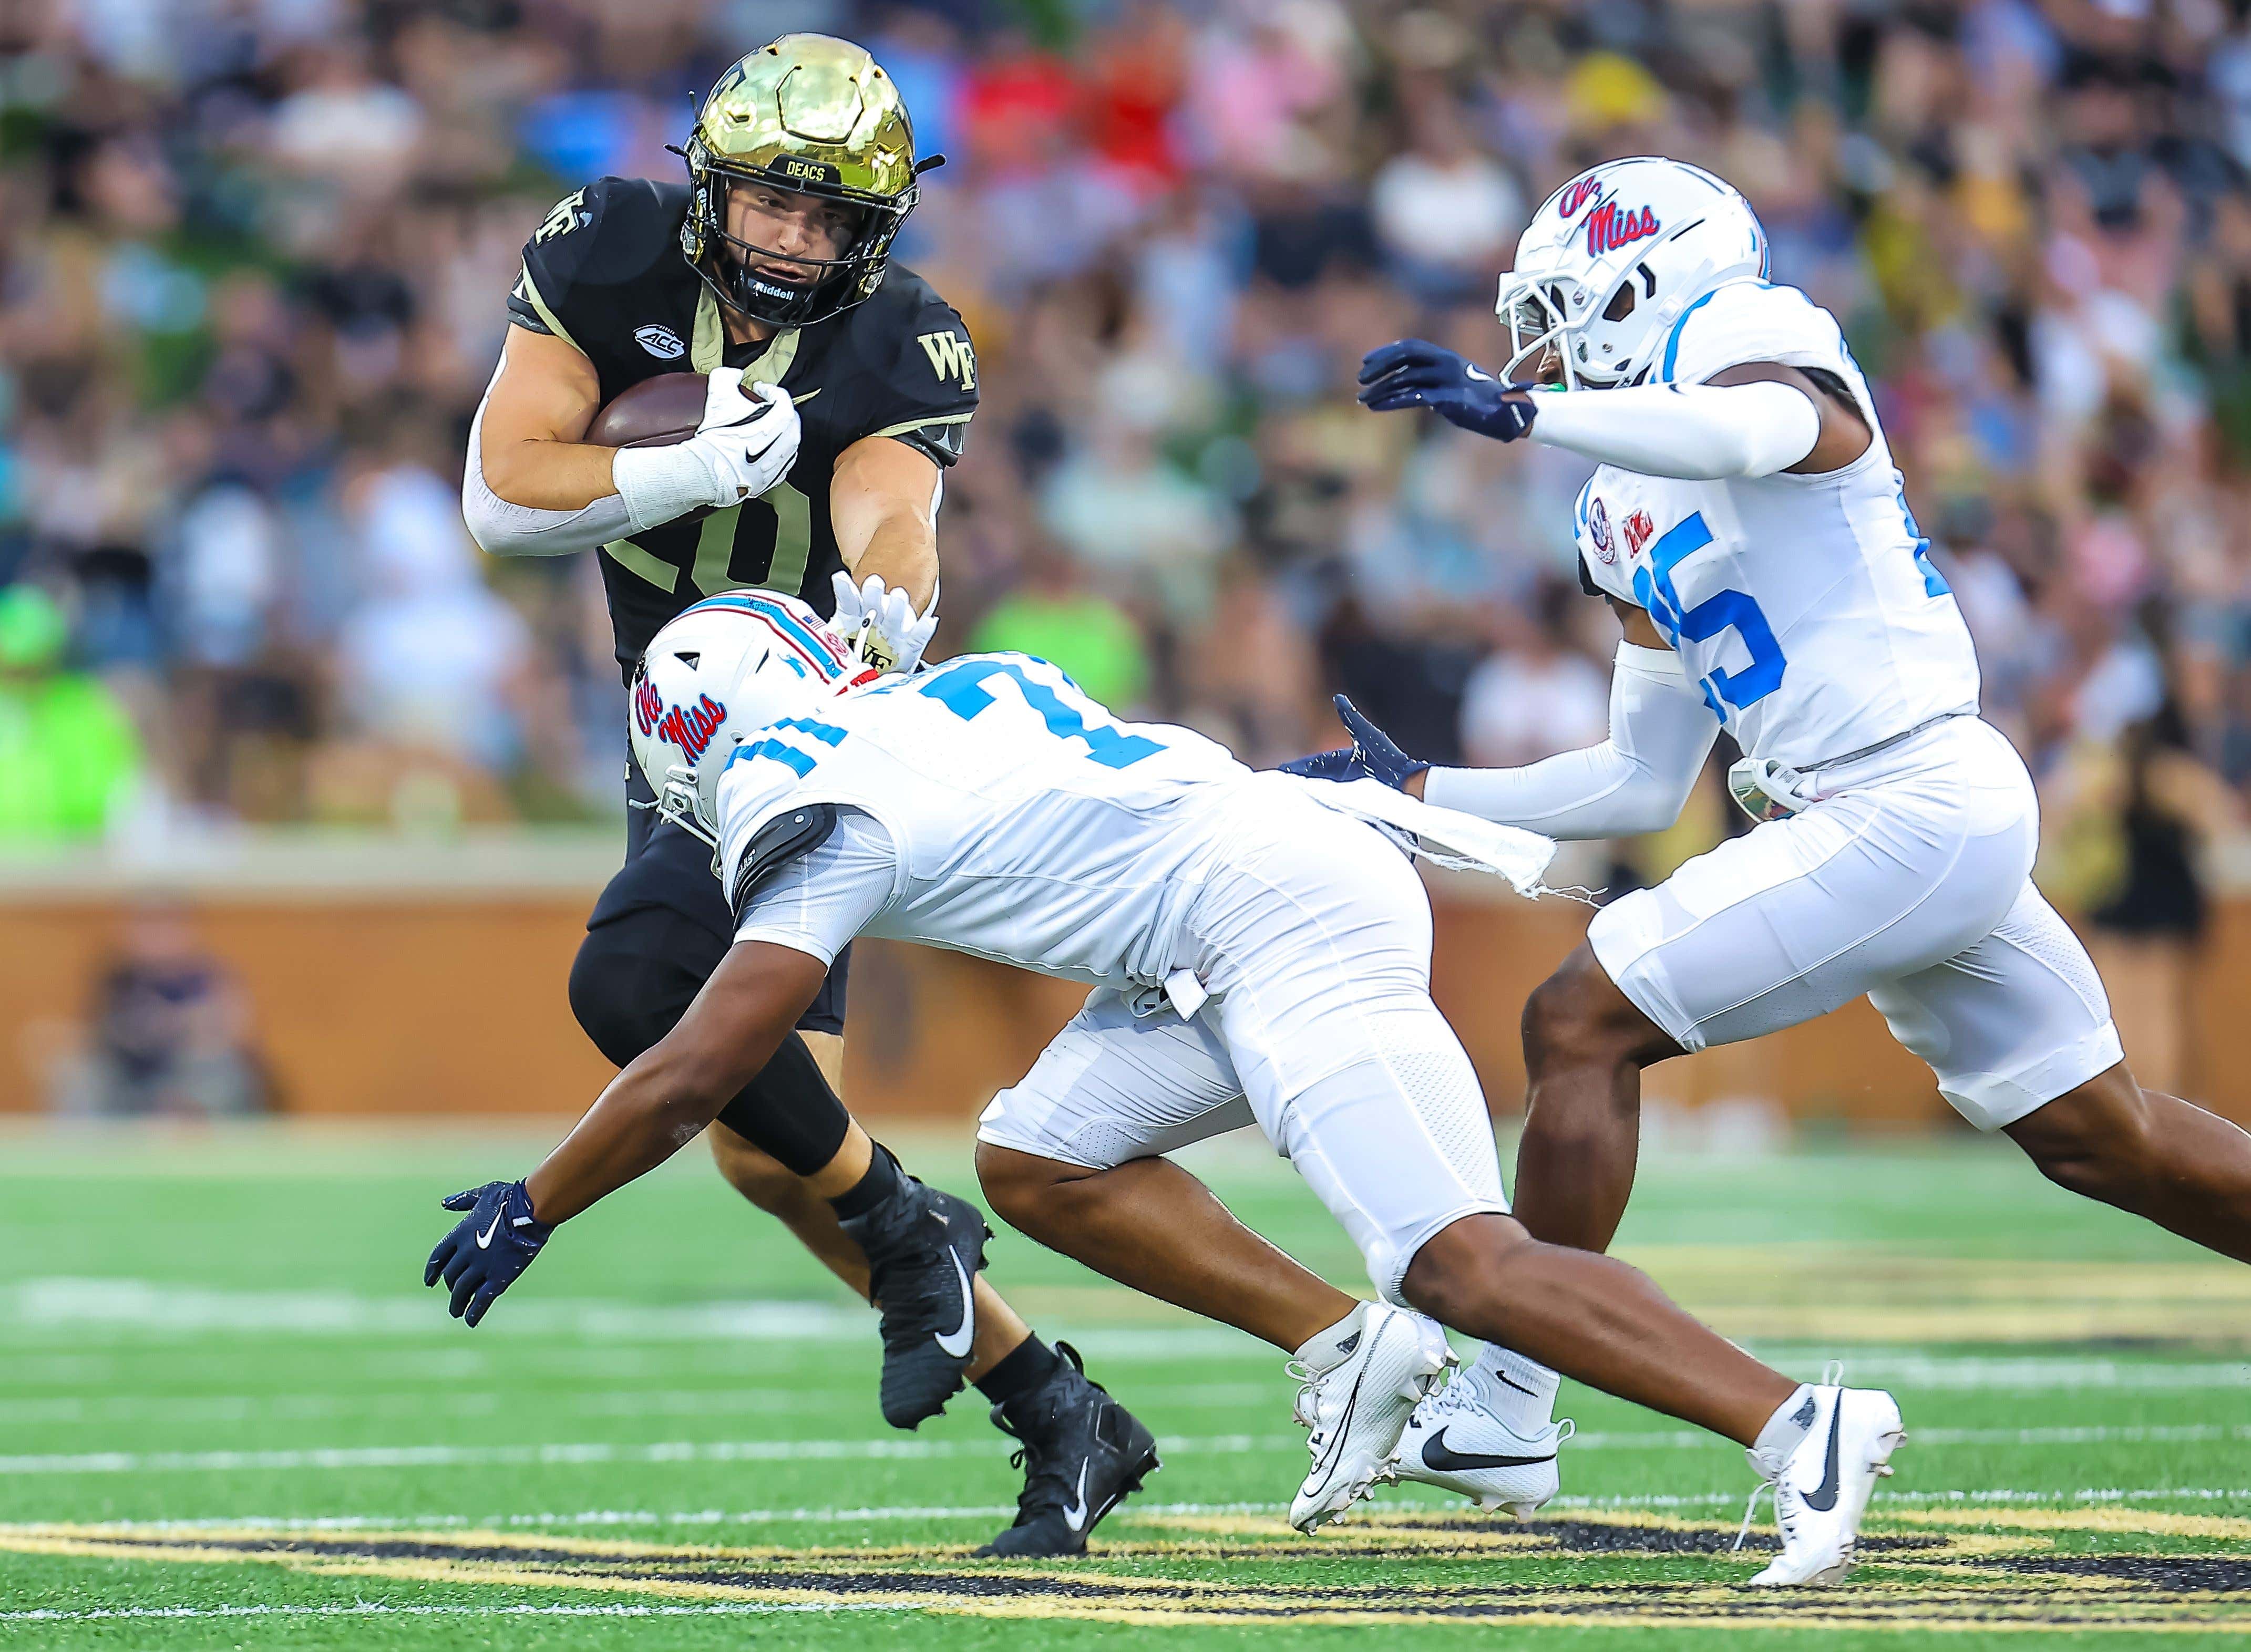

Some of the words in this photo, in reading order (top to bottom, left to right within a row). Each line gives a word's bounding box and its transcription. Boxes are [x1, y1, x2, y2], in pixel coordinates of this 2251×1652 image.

[786, 161, 825, 182] DEACS
[1580, 201, 1660, 257] Miss
[753, 282, 794, 301] Riddell
[640, 333, 682, 353] ACC
[917, 331, 975, 391] WF
[635, 672, 663, 737] Ole
[659, 693, 726, 767] Miss
